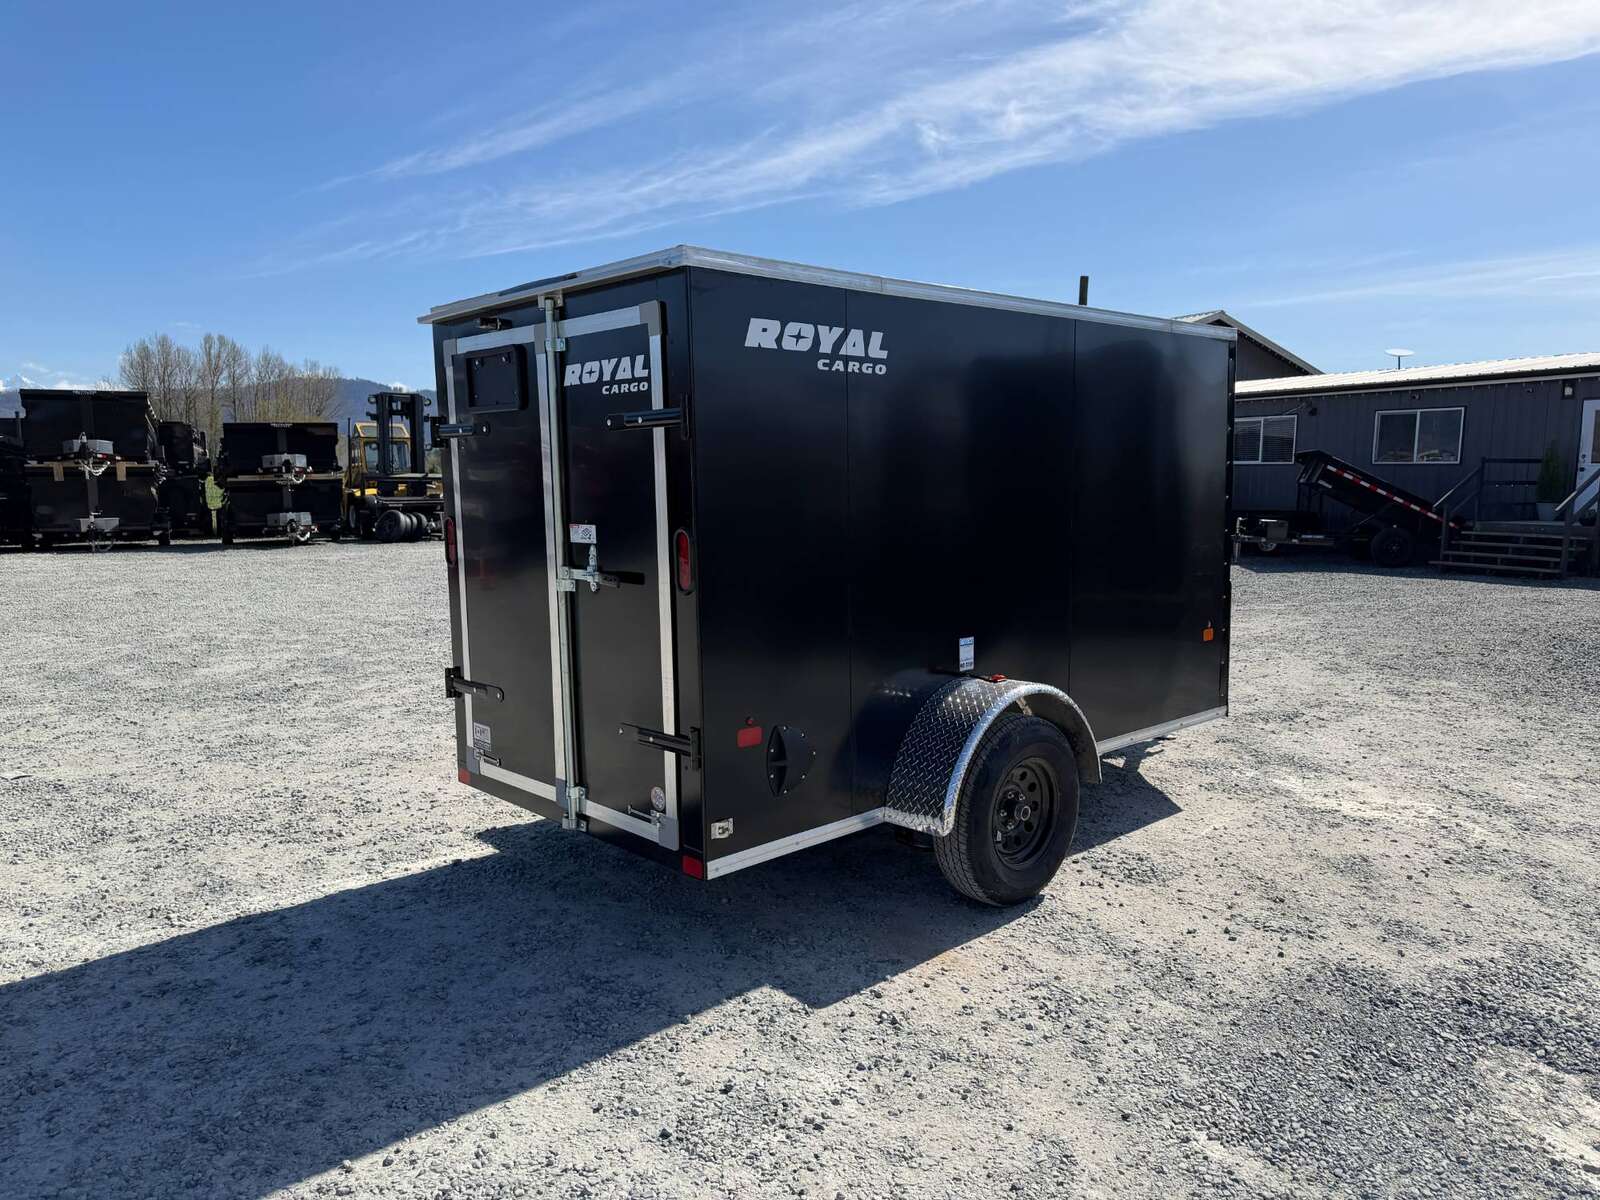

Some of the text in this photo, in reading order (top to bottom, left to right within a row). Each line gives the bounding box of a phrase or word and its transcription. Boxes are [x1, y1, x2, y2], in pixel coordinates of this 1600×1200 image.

[744, 317, 889, 359] ROYAL
[563, 354, 649, 387] ROYAL
[817, 359, 888, 375] CARGO
[601, 381, 649, 395] CARGO
